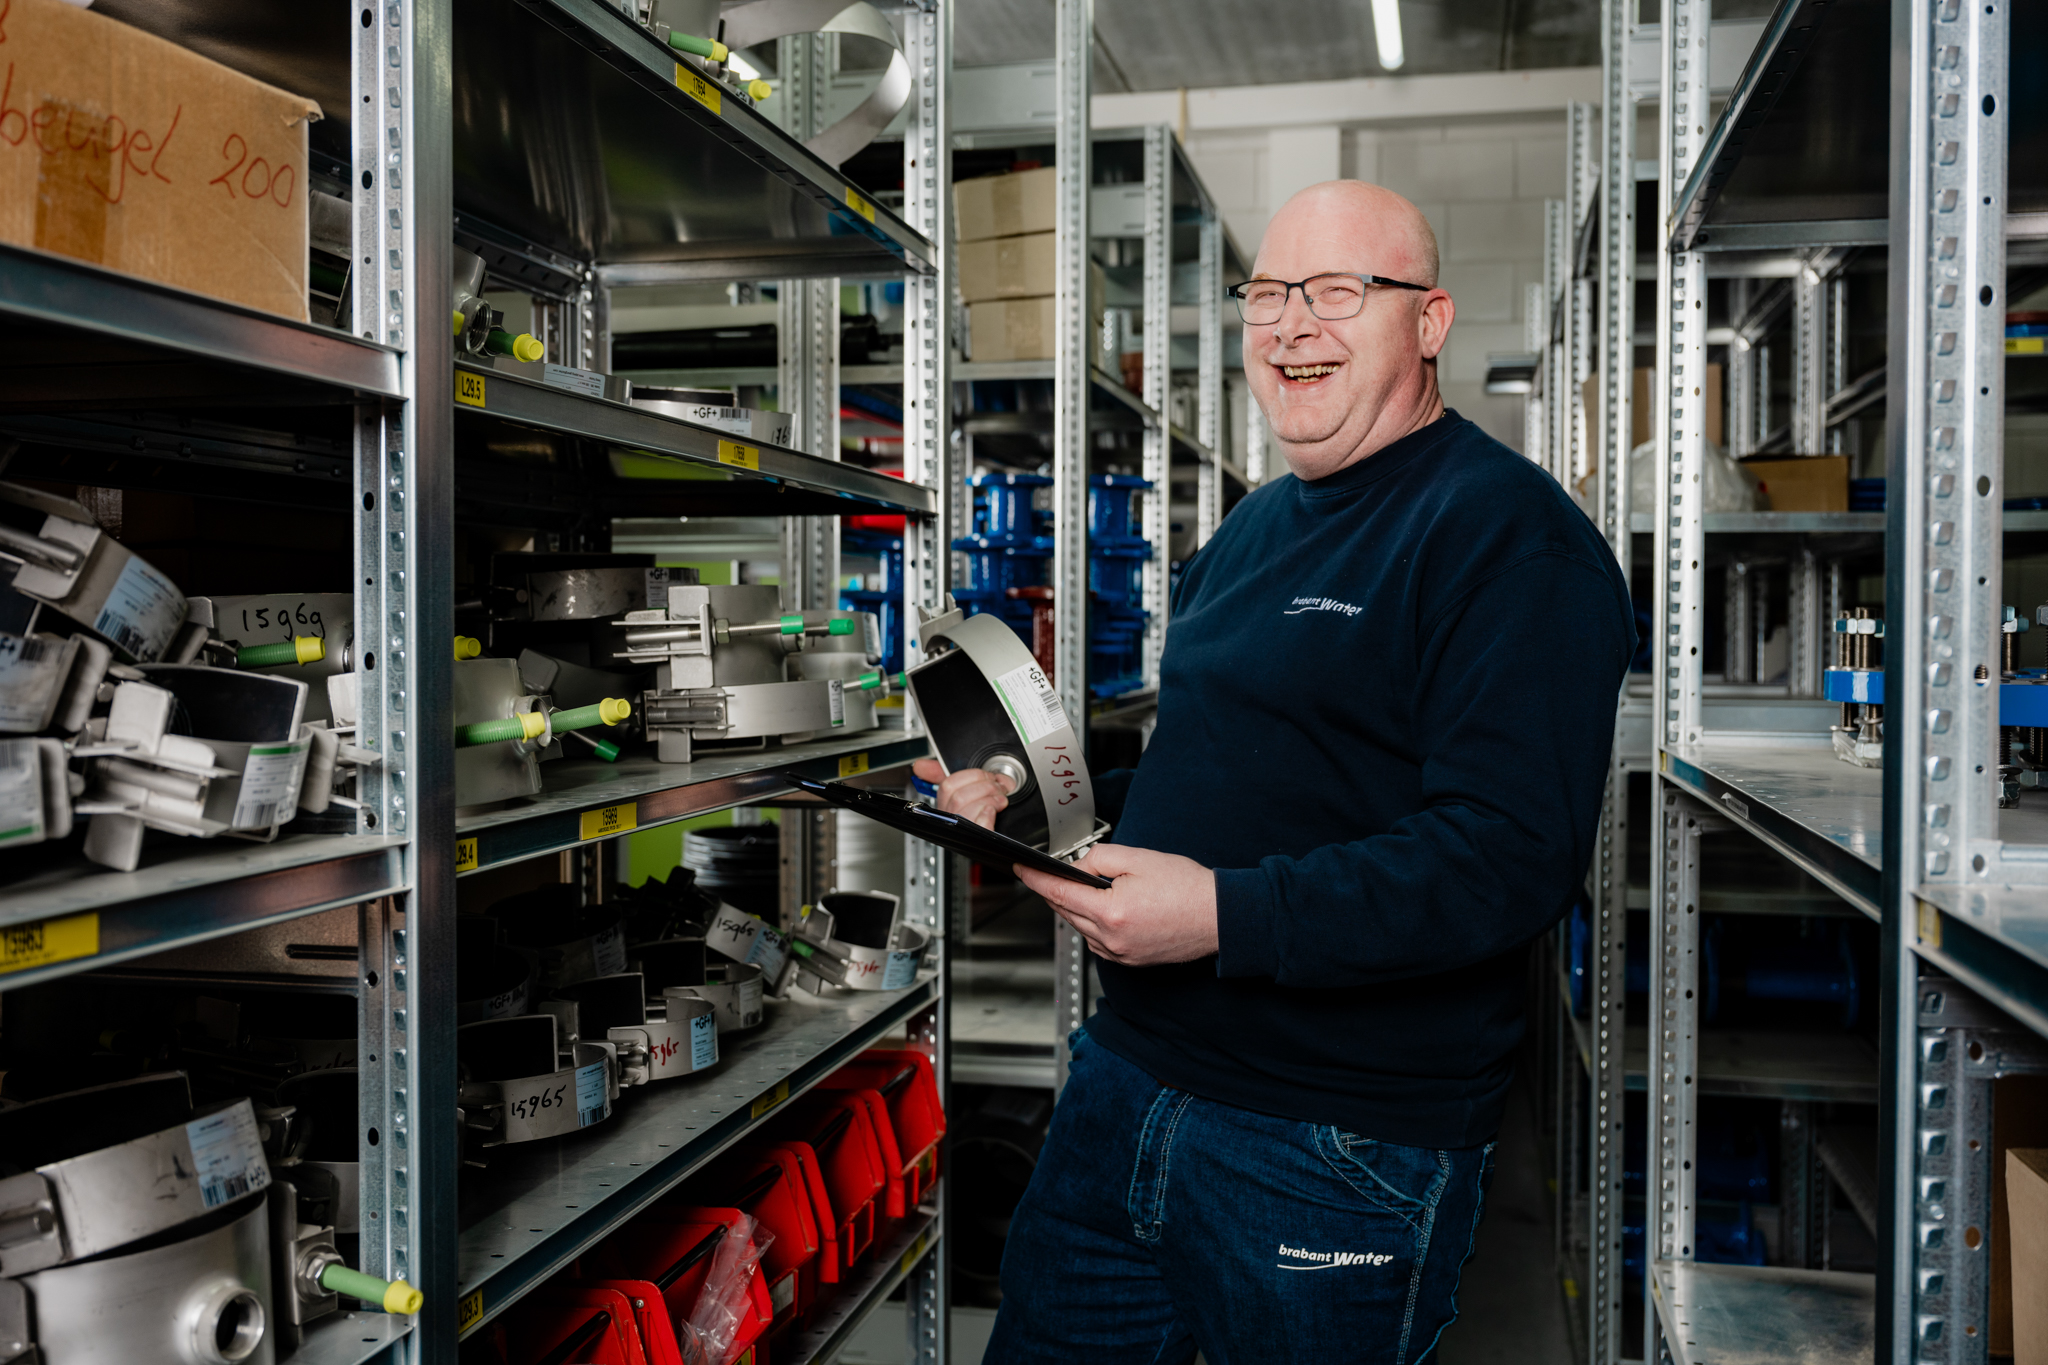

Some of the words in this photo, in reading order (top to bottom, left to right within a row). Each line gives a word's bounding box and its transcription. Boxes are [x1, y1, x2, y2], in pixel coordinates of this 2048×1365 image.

[209, 134, 295, 207] 200
[461, 375, 481, 400] L29.5
[693, 407, 717, 419] +GF+
[1028, 666, 1046, 689] +GF+
[511, 1084, 567, 1119] 15965
[1278, 1243, 1332, 1262] brabant
[1333, 1251, 1393, 1266] Water
